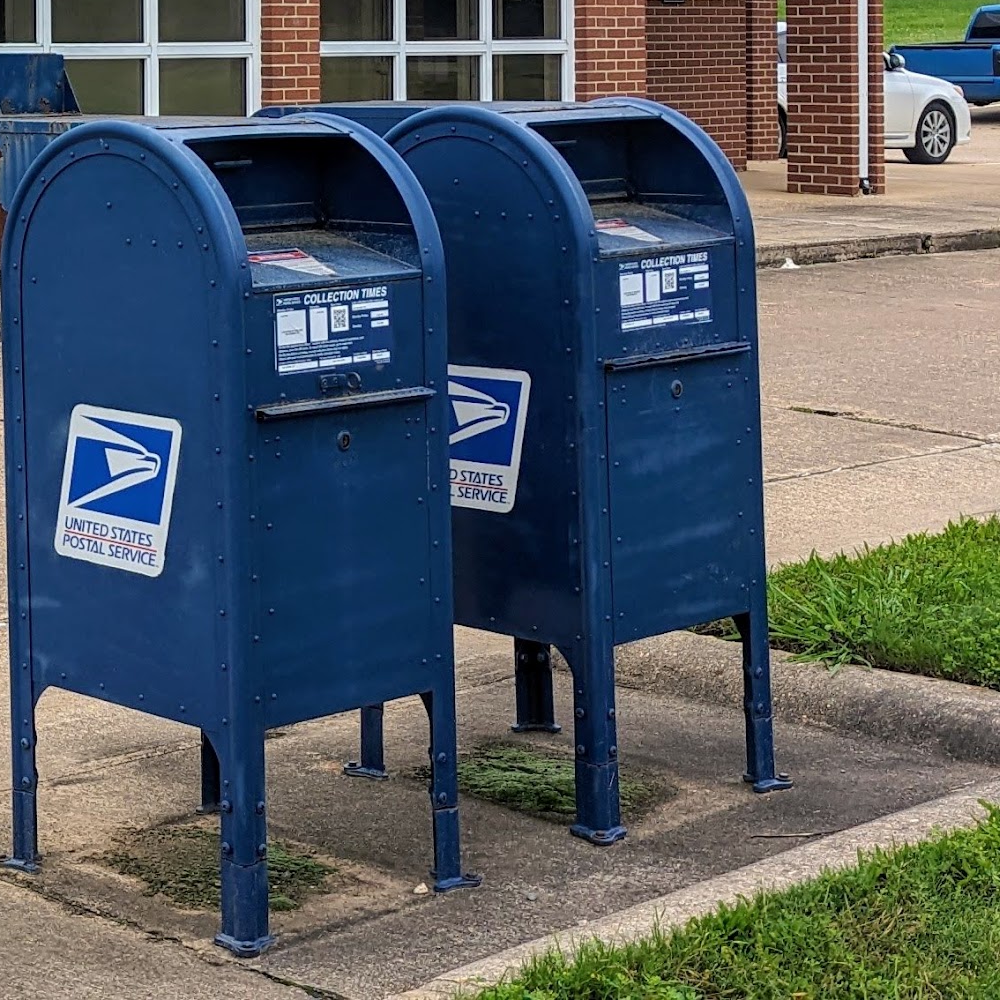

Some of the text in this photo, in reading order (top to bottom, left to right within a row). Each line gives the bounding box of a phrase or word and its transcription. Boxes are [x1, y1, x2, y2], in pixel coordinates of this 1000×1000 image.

[641, 254, 686, 269] COLLECTION
[686, 252, 708, 263] TIMES
[303, 288, 360, 305] COLLECTION
[361, 286, 387, 299] TIMES
[460, 469, 504, 486] STATES
[457, 486, 508, 504] SERVICE
[65, 516, 153, 547] UNITED STATES
[63, 534, 157, 567] POSTAL SERVICE
